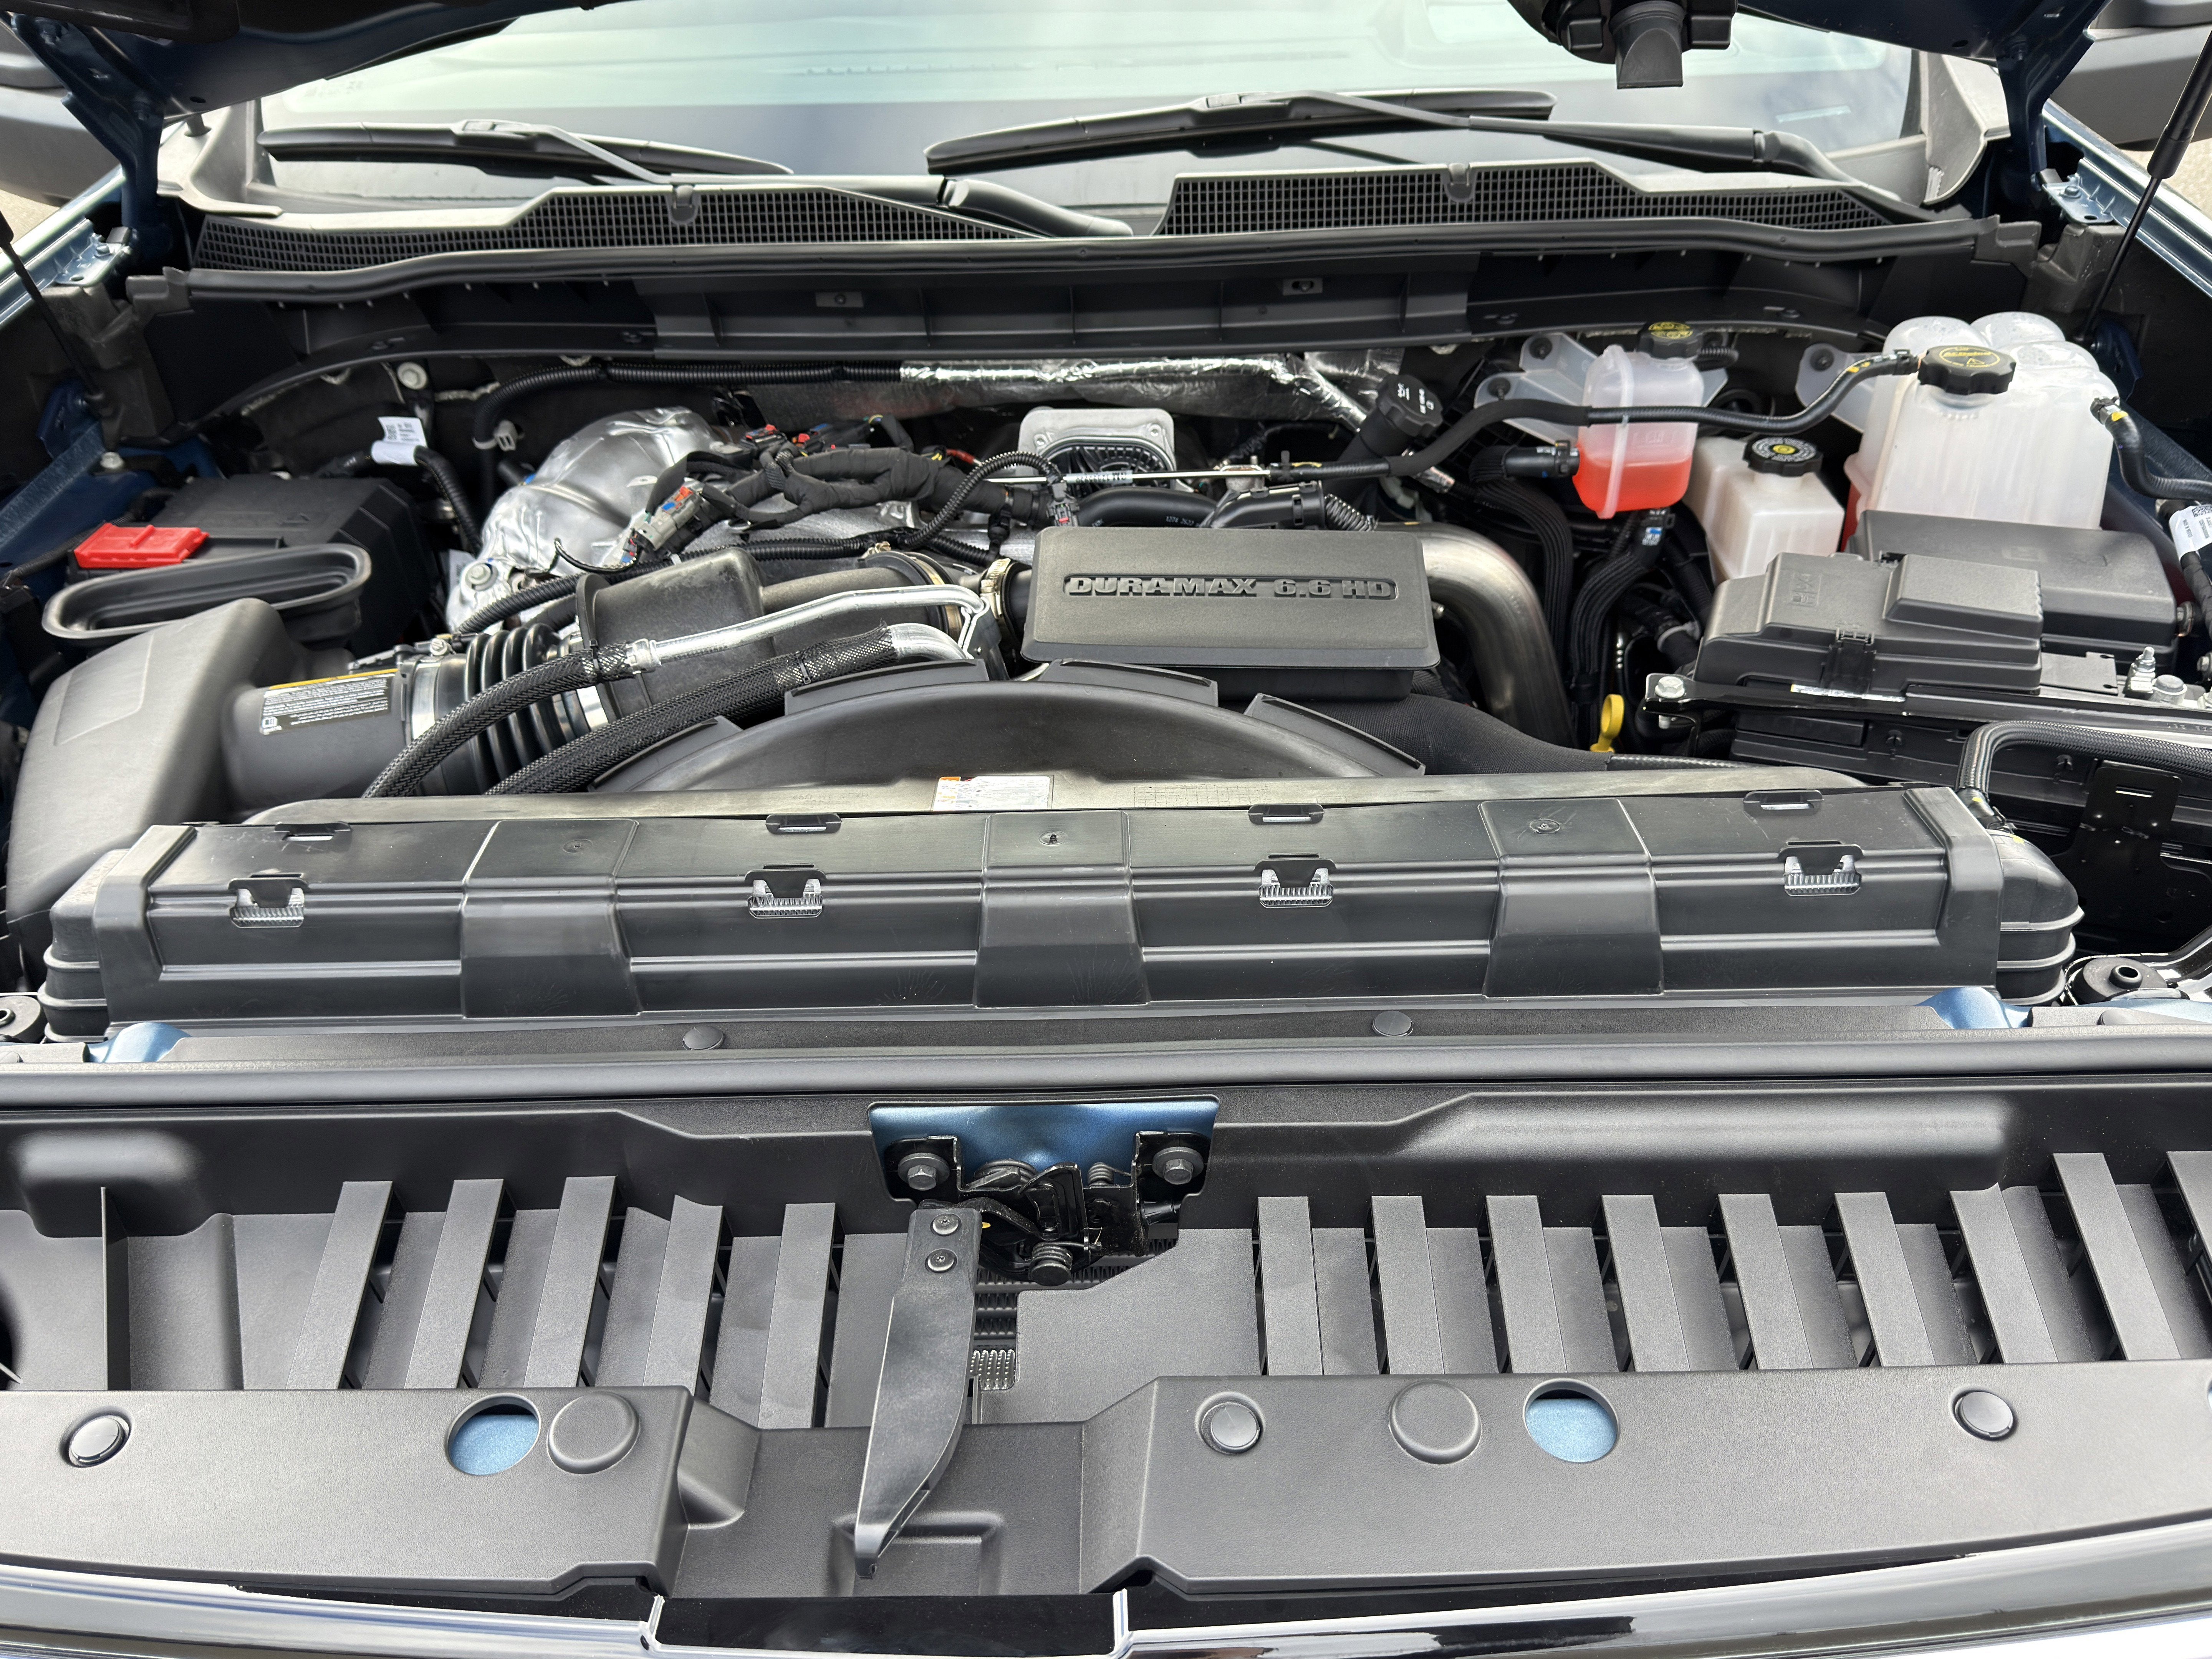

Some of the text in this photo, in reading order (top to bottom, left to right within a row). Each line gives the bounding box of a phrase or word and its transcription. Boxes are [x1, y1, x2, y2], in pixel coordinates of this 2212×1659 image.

[1069, 577, 1391, 599] DURAMAX 6.6 HD
